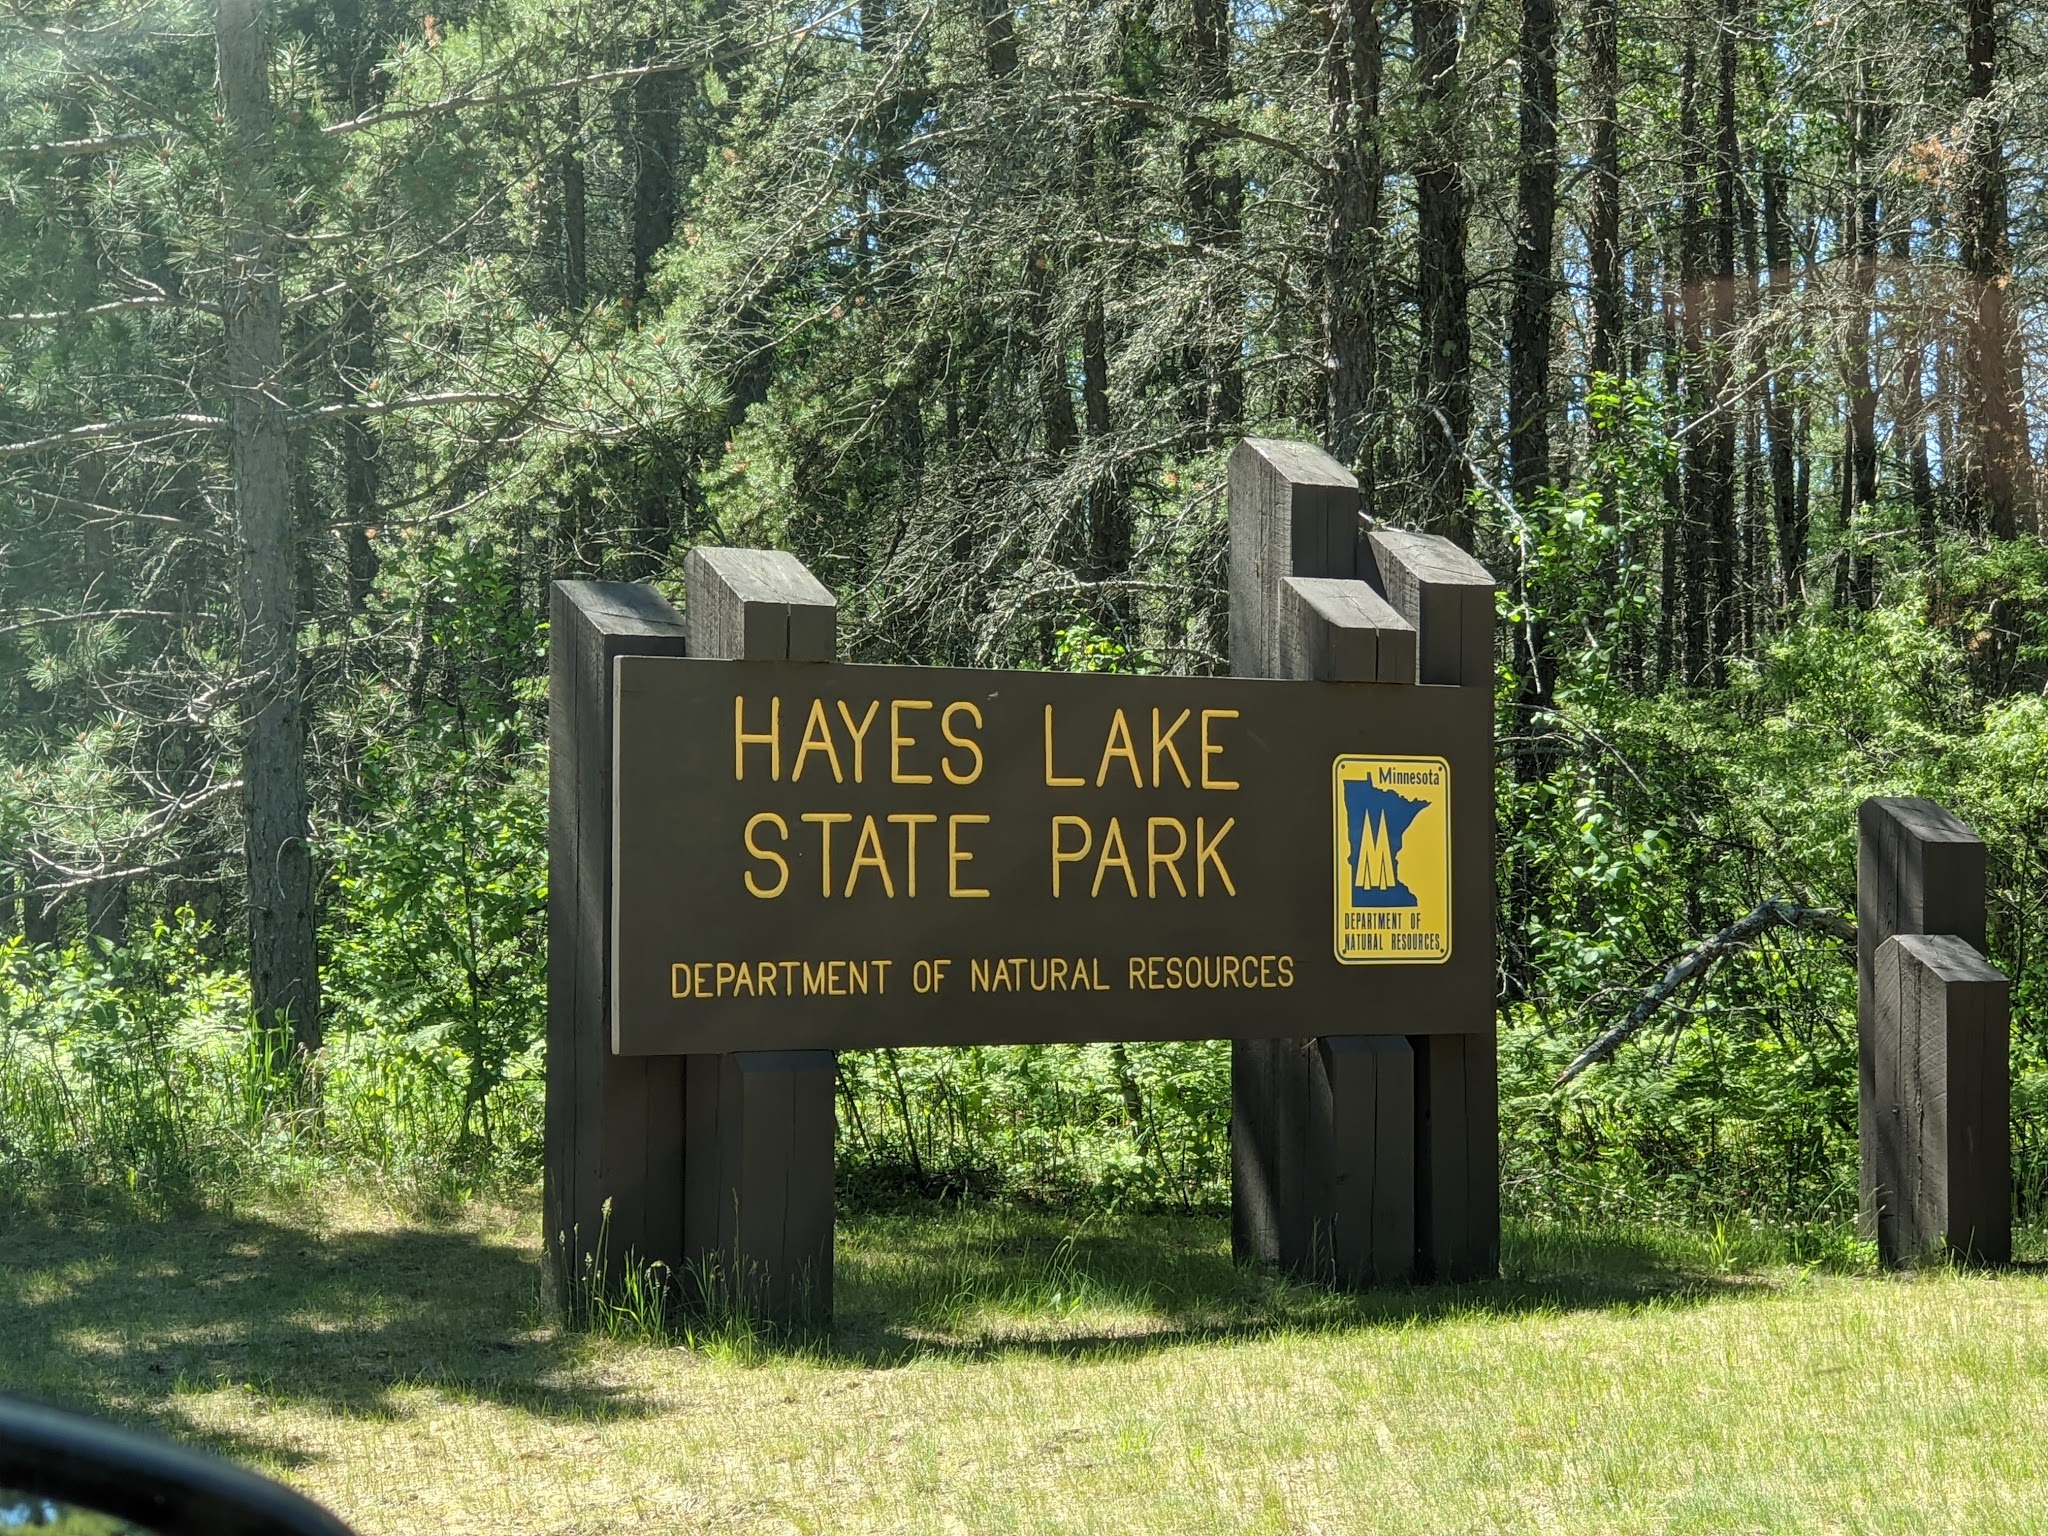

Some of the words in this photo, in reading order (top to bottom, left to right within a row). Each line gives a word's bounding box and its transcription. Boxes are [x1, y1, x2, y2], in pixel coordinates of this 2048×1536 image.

[735, 695, 983, 785] HAYES
[1045, 704, 1240, 791] LAKE
[1379, 767, 1440, 786] Minnesota
[744, 812, 990, 899] STATE
[1052, 815, 1237, 898] PARK
[1345, 912, 1402, 930] DEPARTMENT
[1410, 912, 1421, 930] OF
[1345, 933, 1384, 951] NATURAL
[1391, 933, 1440, 951] RESOURCES
[671, 960, 893, 999] DEPARTMENT
[913, 959, 952, 994] OF
[971, 957, 1110, 992] NATURAL
[1129, 955, 1294, 990] RESOURCES
